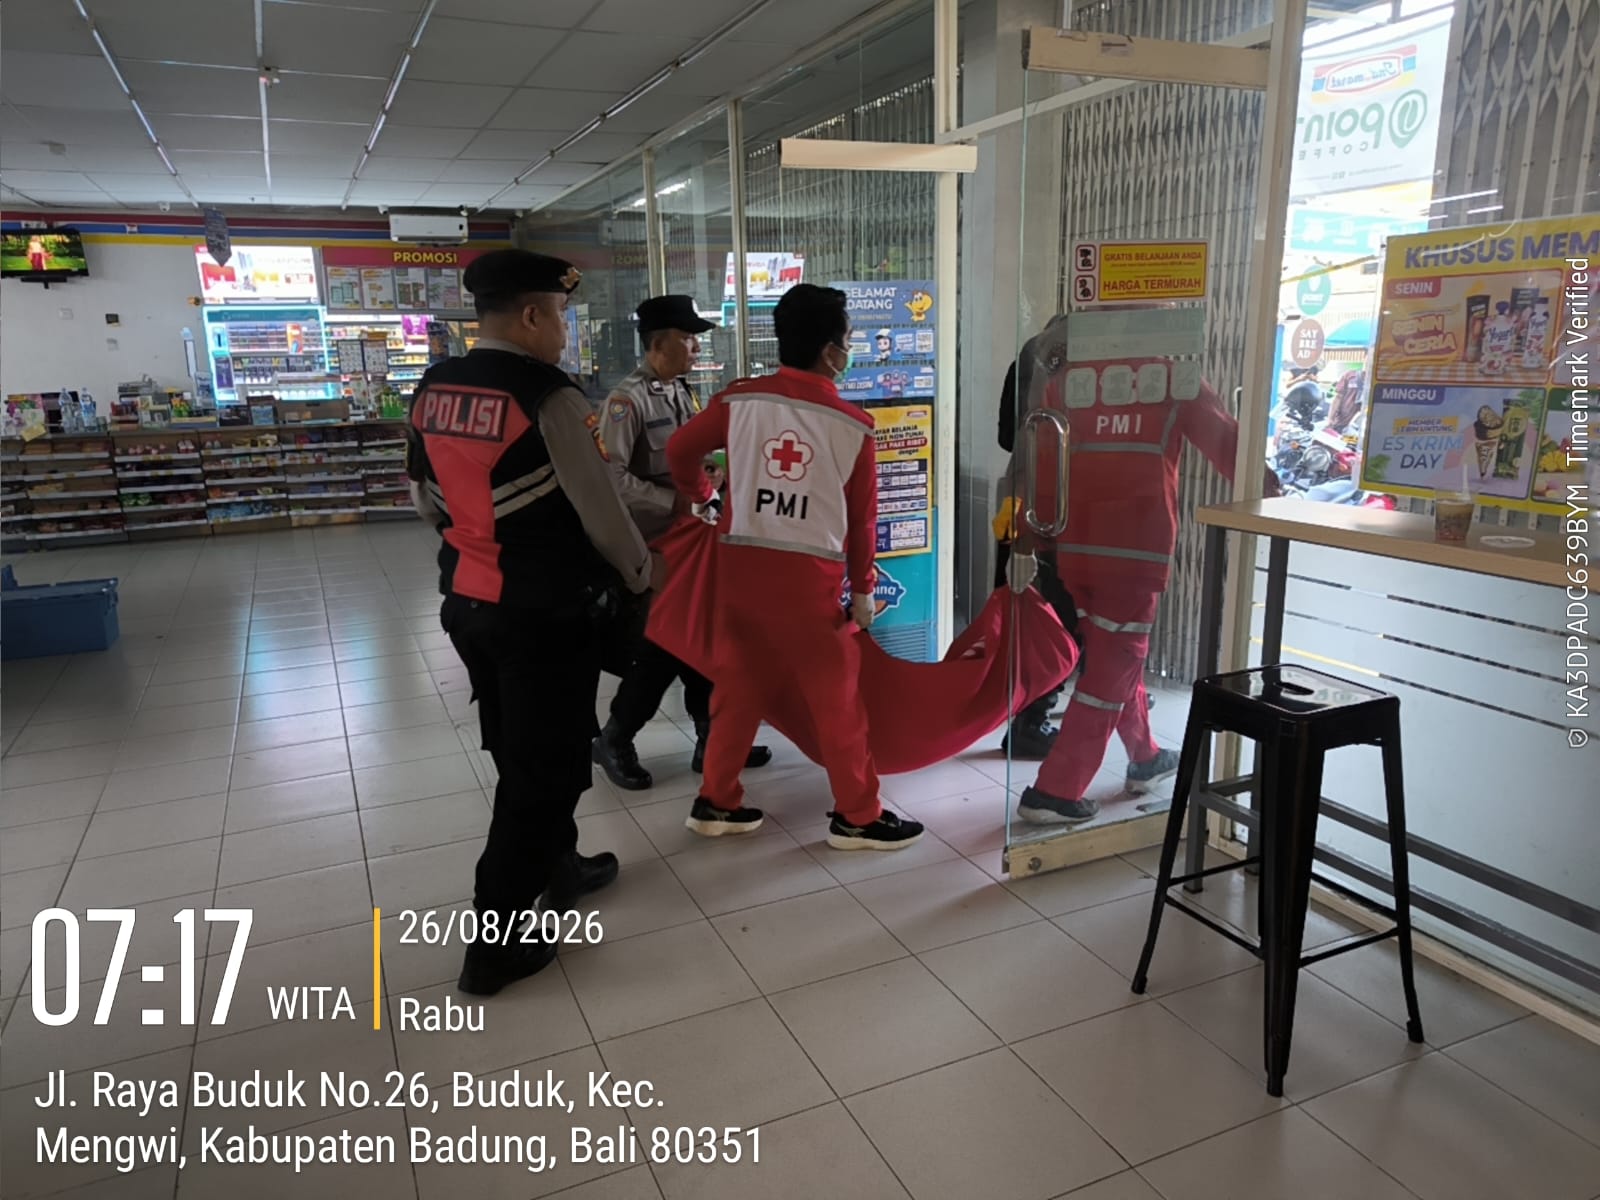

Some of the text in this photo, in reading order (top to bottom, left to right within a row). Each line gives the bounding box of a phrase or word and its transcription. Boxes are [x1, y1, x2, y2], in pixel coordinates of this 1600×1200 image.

[1104, 250, 1202, 261] GRATIS BELANJAAN ANDA
[1405, 230, 1600, 269] KHUSUS MEM
[393, 251, 458, 264] PROMOSI
[1103, 278, 1201, 291] HARGA TERMURAH
[1395, 281, 1433, 294] SENIN
[845, 287, 897, 298] SELAMAT
[847, 299, 893, 310] DATANG
[1382, 387, 1437, 401] MINGGU
[422, 391, 504, 437] POLISI
[1096, 413, 1142, 435] PMI
[1382, 436, 1464, 451] ES KRIM
[1400, 453, 1443, 469] DAY
[756, 488, 809, 520] PMI
